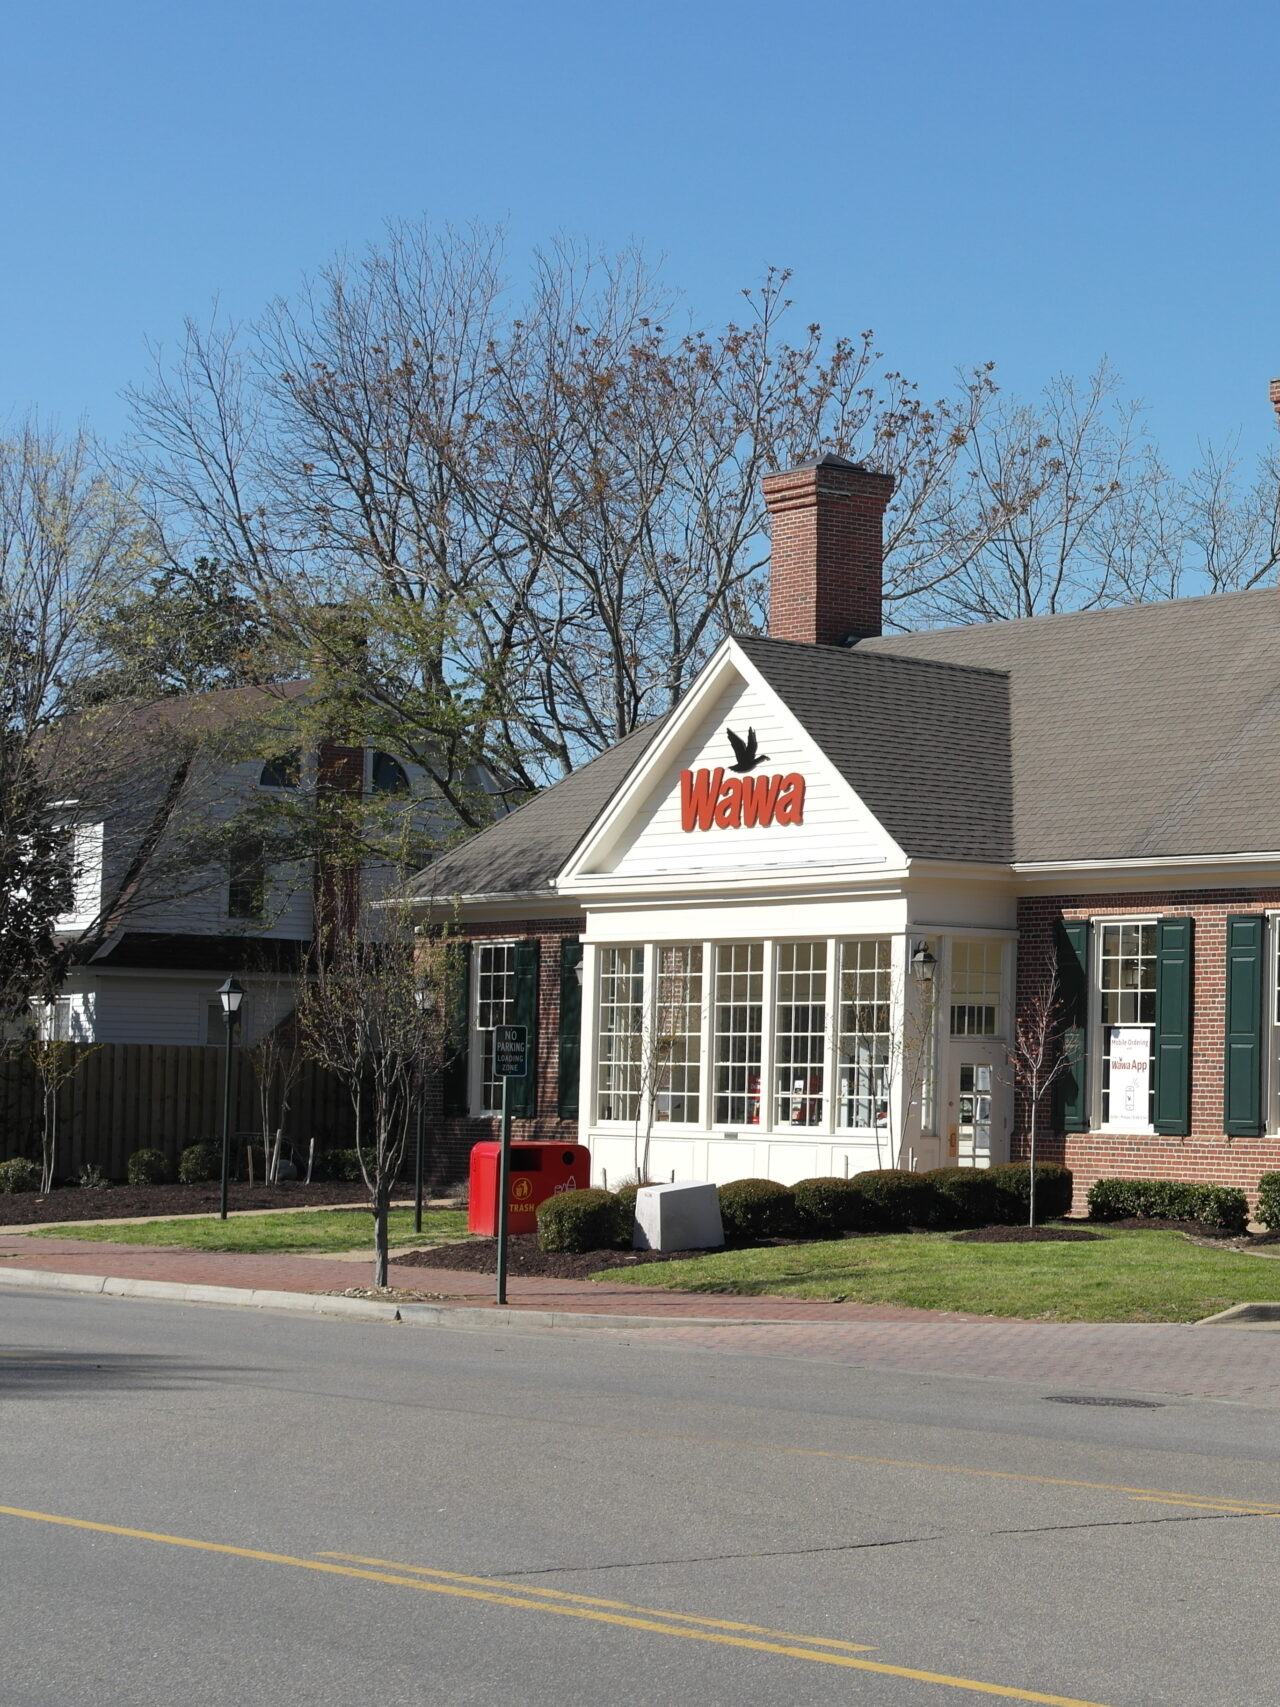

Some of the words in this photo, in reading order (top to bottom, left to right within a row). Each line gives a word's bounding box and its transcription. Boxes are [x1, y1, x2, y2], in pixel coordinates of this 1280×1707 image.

[680, 767, 806, 833] Wawa
[504, 1030, 517, 1041] NO
[497, 1041, 525, 1052] PARKING
[1111, 1039, 1127, 1047] Mobile
[1128, 1039, 1149, 1048] Ordering
[497, 1054, 524, 1063] LOADING
[502, 1064, 519, 1072] ZONE
[1111, 1060, 1131, 1070] Wawa
[1131, 1059, 1148, 1073] App
[509, 1203, 536, 1213] TRASH
